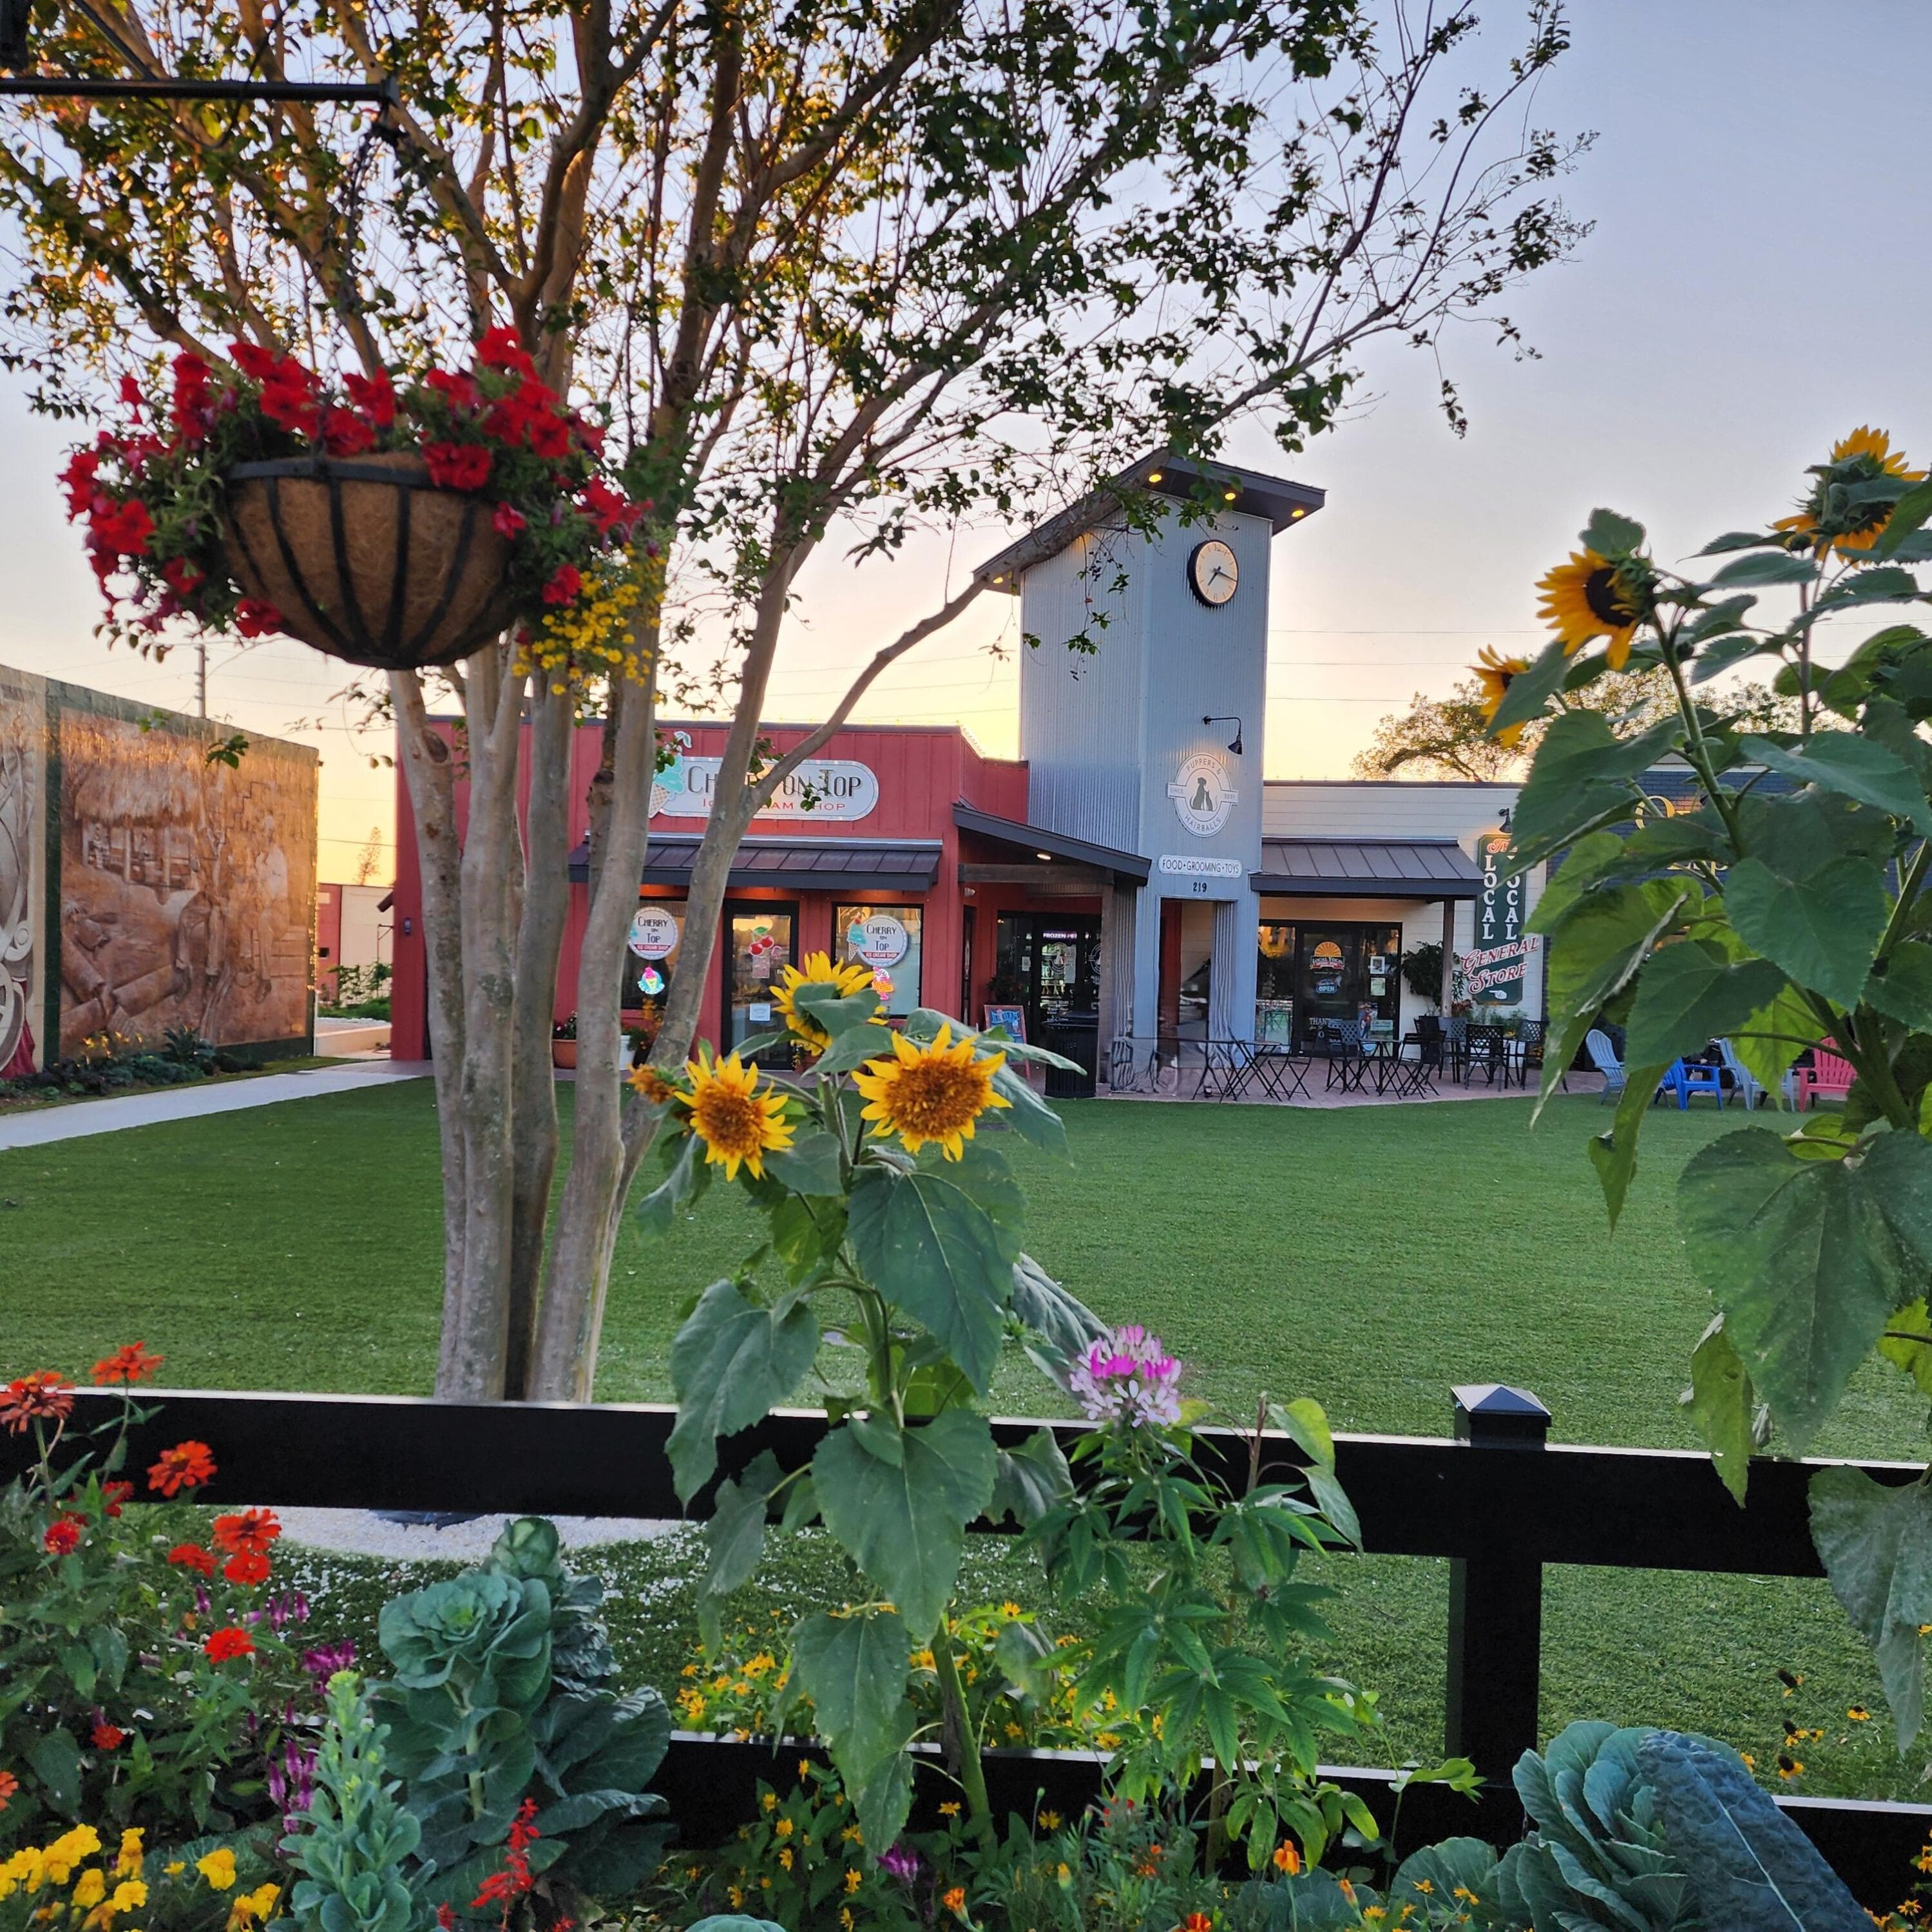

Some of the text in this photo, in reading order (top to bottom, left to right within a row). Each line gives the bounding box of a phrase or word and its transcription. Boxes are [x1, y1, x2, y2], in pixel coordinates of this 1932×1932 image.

[1187, 759, 1215, 772] PUPPERS
[819, 769, 861, 797] TOP
[1185, 814, 1221, 832] HAIRBALLS
[1162, 859, 1239, 874] FOOD GROOMING TOYS
[1192, 881, 1207, 893] 219
[1482, 855, 1498, 940] LOCAL
[1504, 856, 1521, 941] OCAL
[638, 916, 669, 927] CHERRY
[866, 924, 897, 935] CHERRY
[647, 933, 661, 943] TOP
[875, 941, 889, 951] TOP
[1460, 935, 1540, 977] GENERAL
[1469, 962, 1529, 994] STORE
